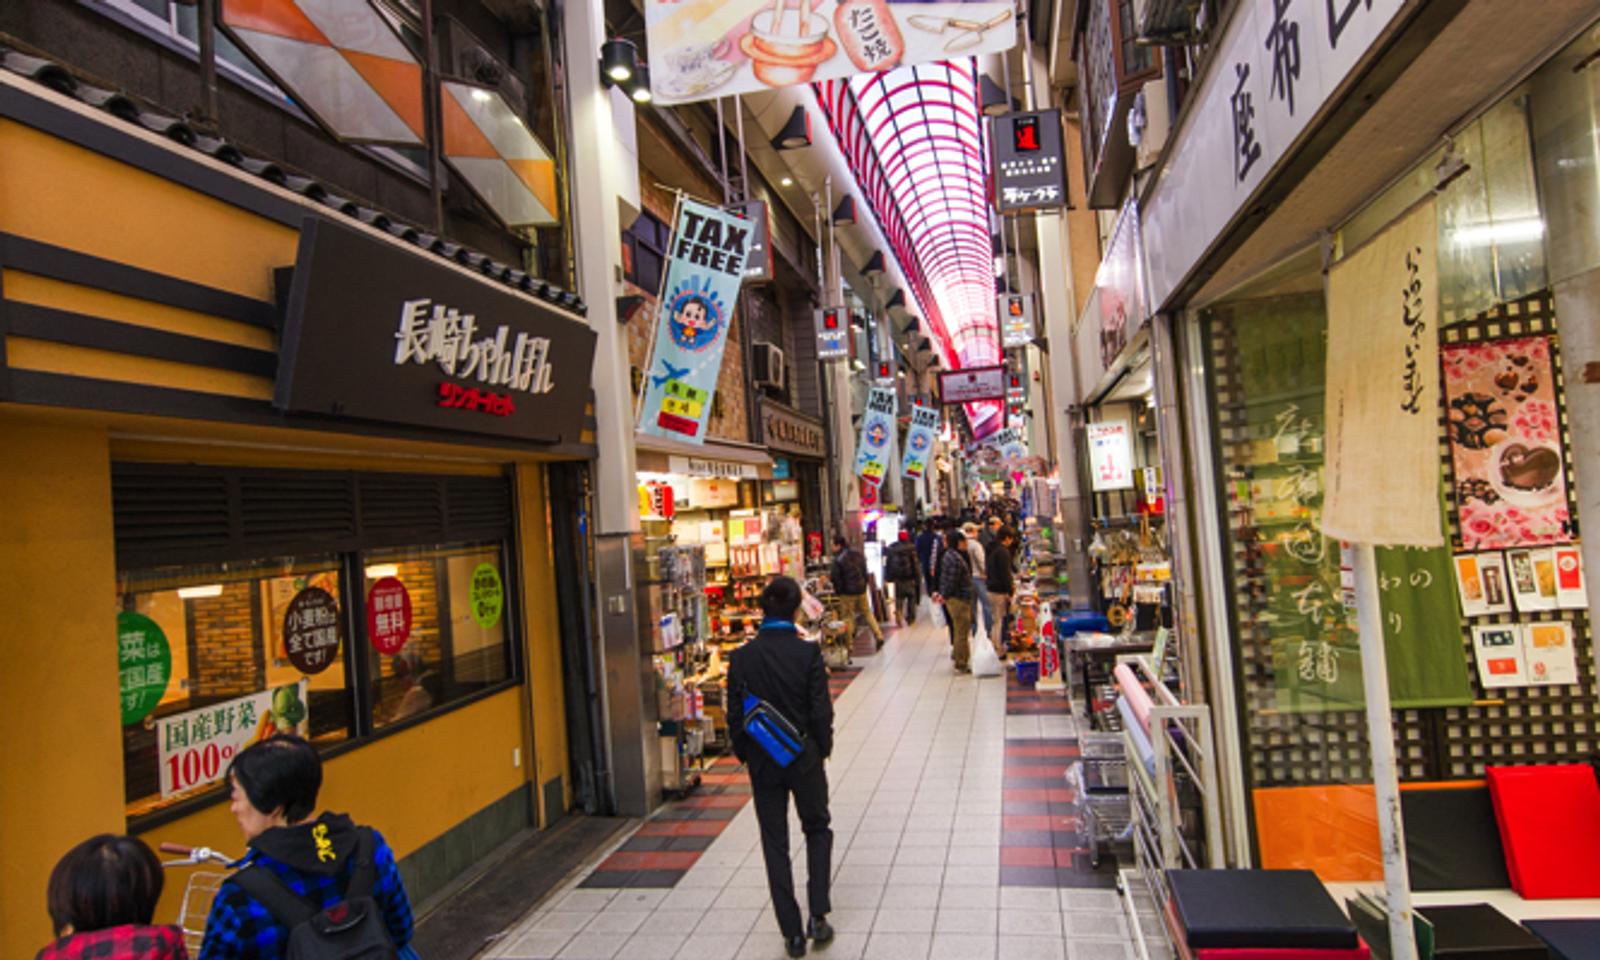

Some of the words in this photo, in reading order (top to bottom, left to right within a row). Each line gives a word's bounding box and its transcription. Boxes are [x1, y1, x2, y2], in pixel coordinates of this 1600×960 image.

[850, 7, 892, 63] たこ焼
[676, 238, 743, 276] FREE
[683, 210, 747, 255] TAX
[394, 299, 555, 394] 長崎ちゃんぽん
[1401, 247, 1426, 415] いらっしゃいませ
[166, 700, 257, 753] 国産野菜
